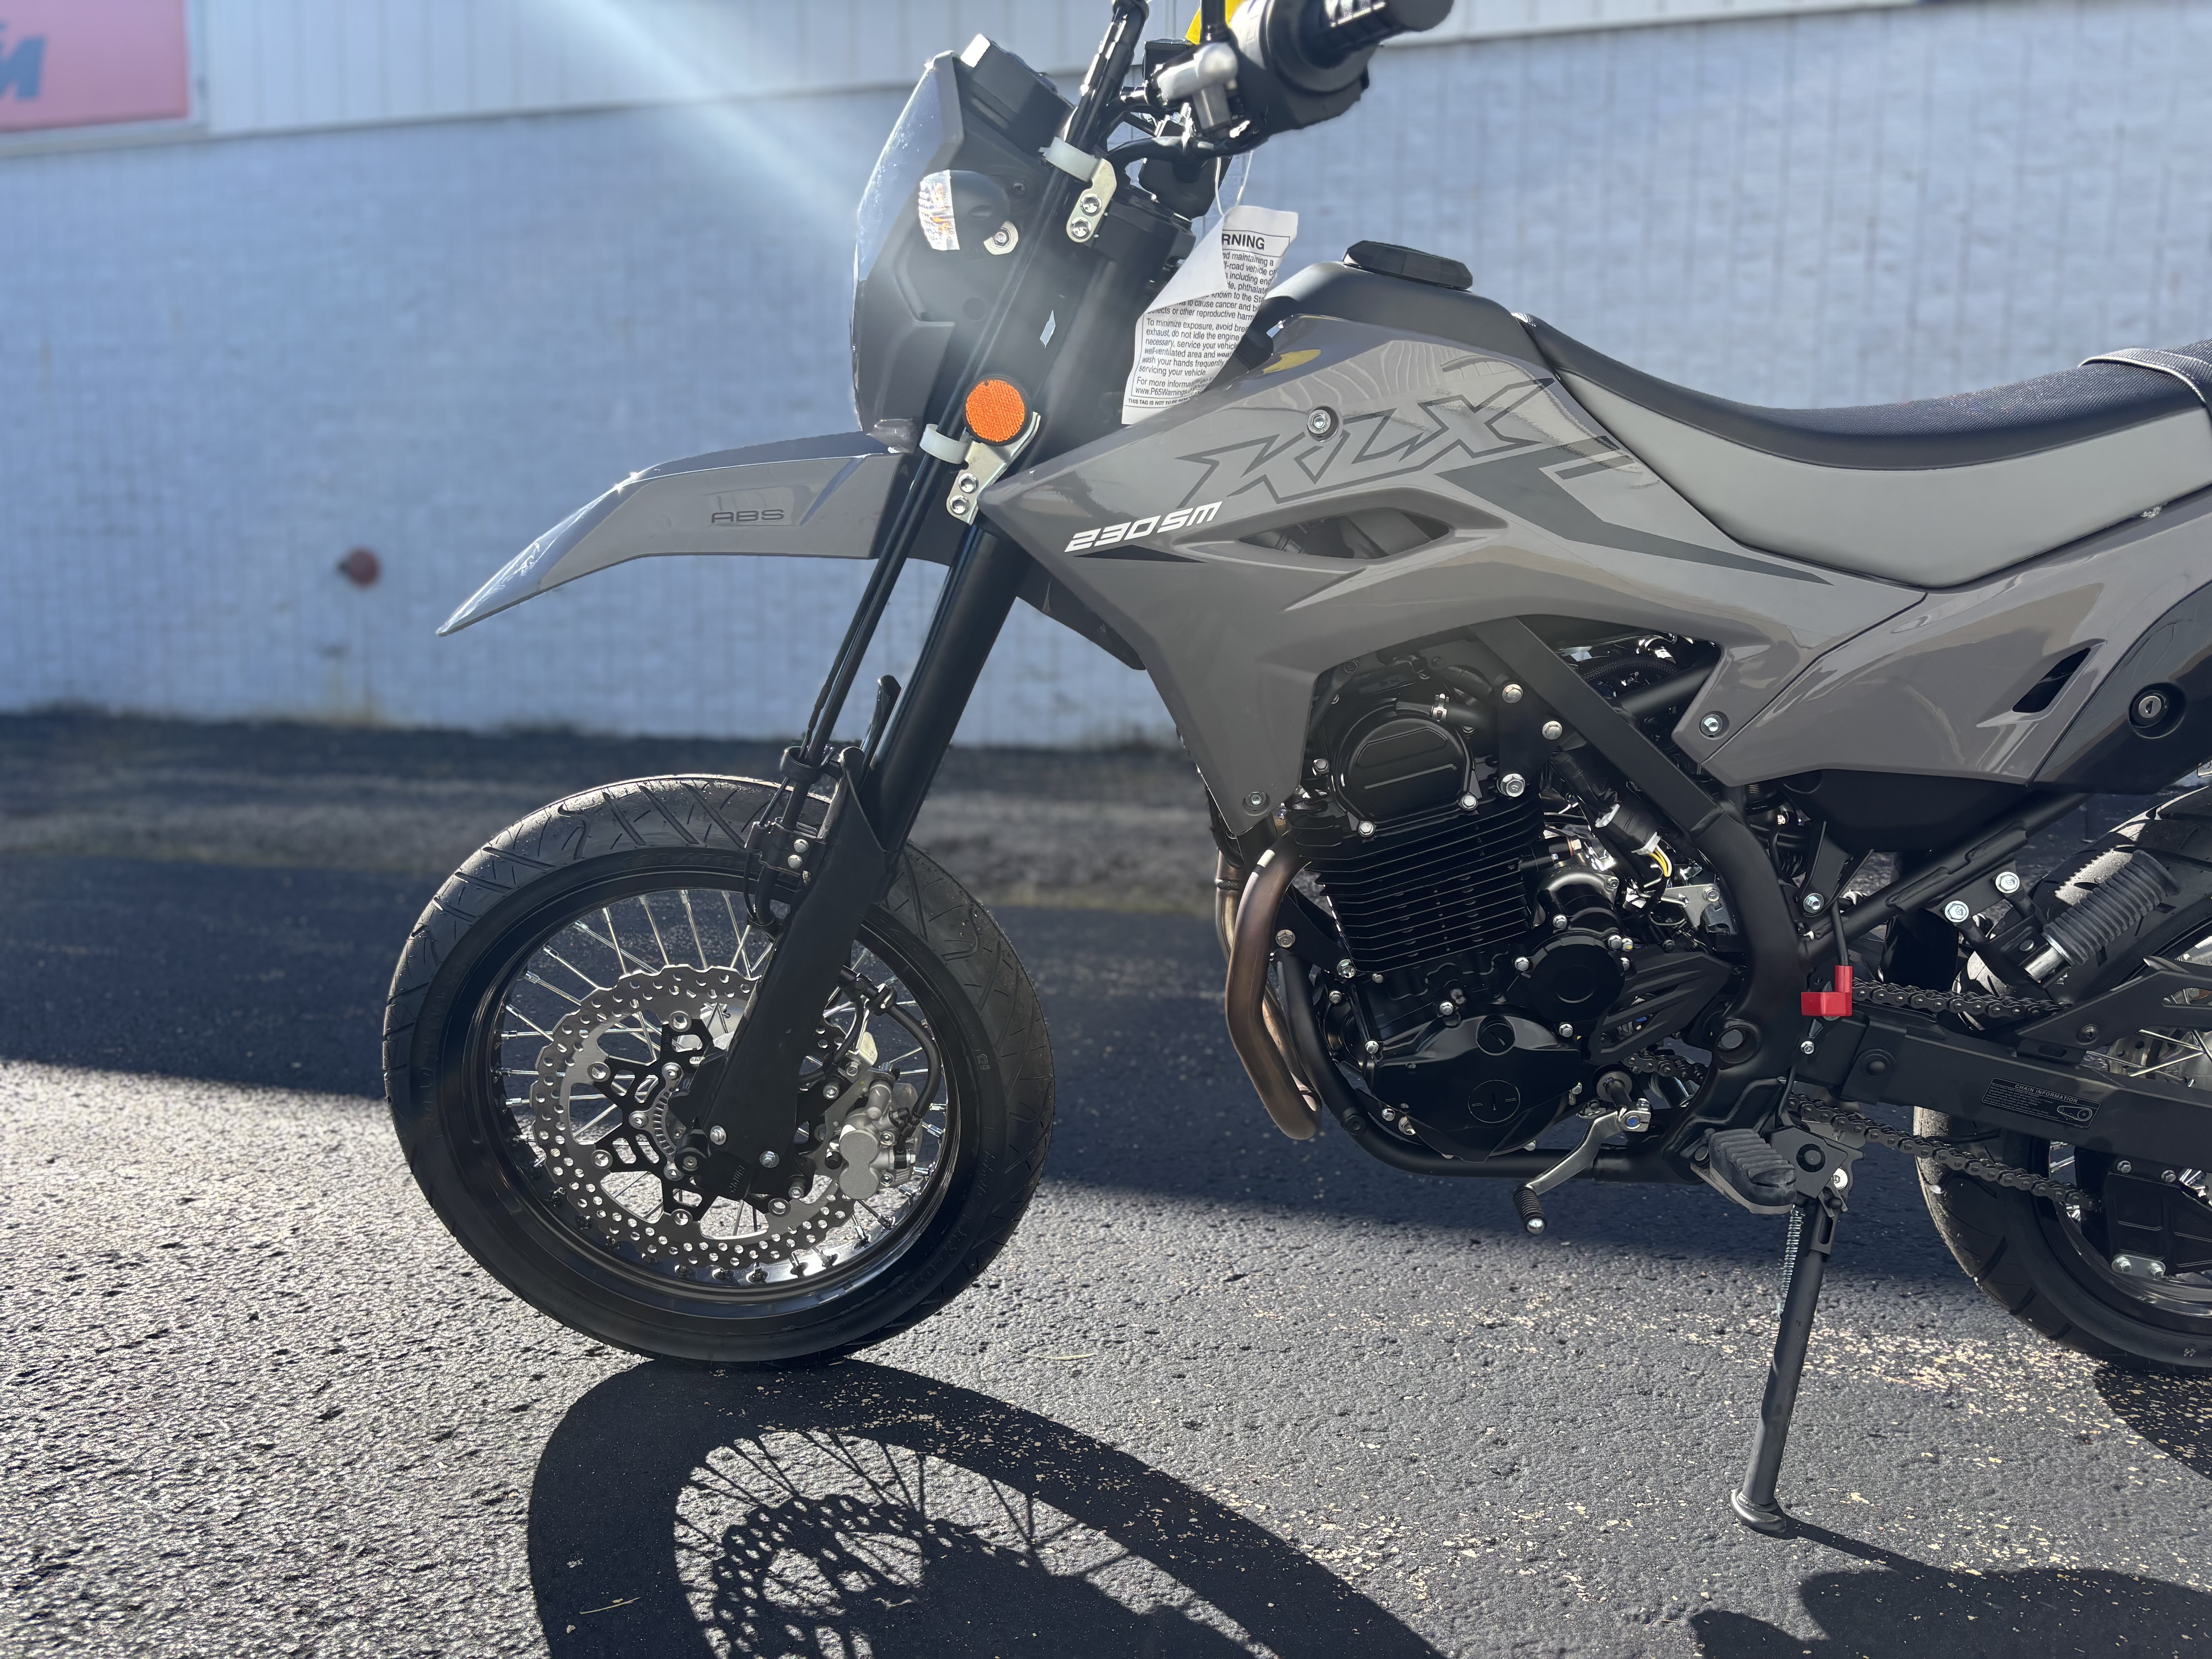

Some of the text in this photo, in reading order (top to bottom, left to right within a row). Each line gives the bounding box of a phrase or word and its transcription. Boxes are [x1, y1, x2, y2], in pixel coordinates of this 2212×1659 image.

[1222, 234, 1265, 250] RNING
[1232, 253, 1267, 267] maintaining
[1224, 261, 1244, 270] f-road
[1246, 265, 1267, 275] vehicle
[1230, 271, 1258, 285] including
[1238, 283, 1267, 294] phthalate
[1242, 293, 1252, 301] the
[1180, 307, 1195, 316] other
[1197, 310, 1235, 318] reproductive
[1156, 319, 1181, 328] minimize
[1183, 322, 1214, 331] exposure,
[1216, 323, 1233, 331] avoid
[1194, 331, 1204, 339] idle
[1218, 333, 1239, 342] engine
[1145, 347, 1186, 357] well-ventilated
[1202, 343, 1216, 351] your
[1158, 358, 1172, 366] your
[1173, 358, 1194, 367] hands
[1195, 359, 1224, 368] frequently
[1139, 366, 1166, 376] servicing
[1168, 369, 1183, 377] your
[1137, 376, 1147, 385] For
[1175, 378, 1556, 508] KLX
[711, 509, 784, 523] ABS
[2035, 1089, 2078, 1103] INFORMATION
